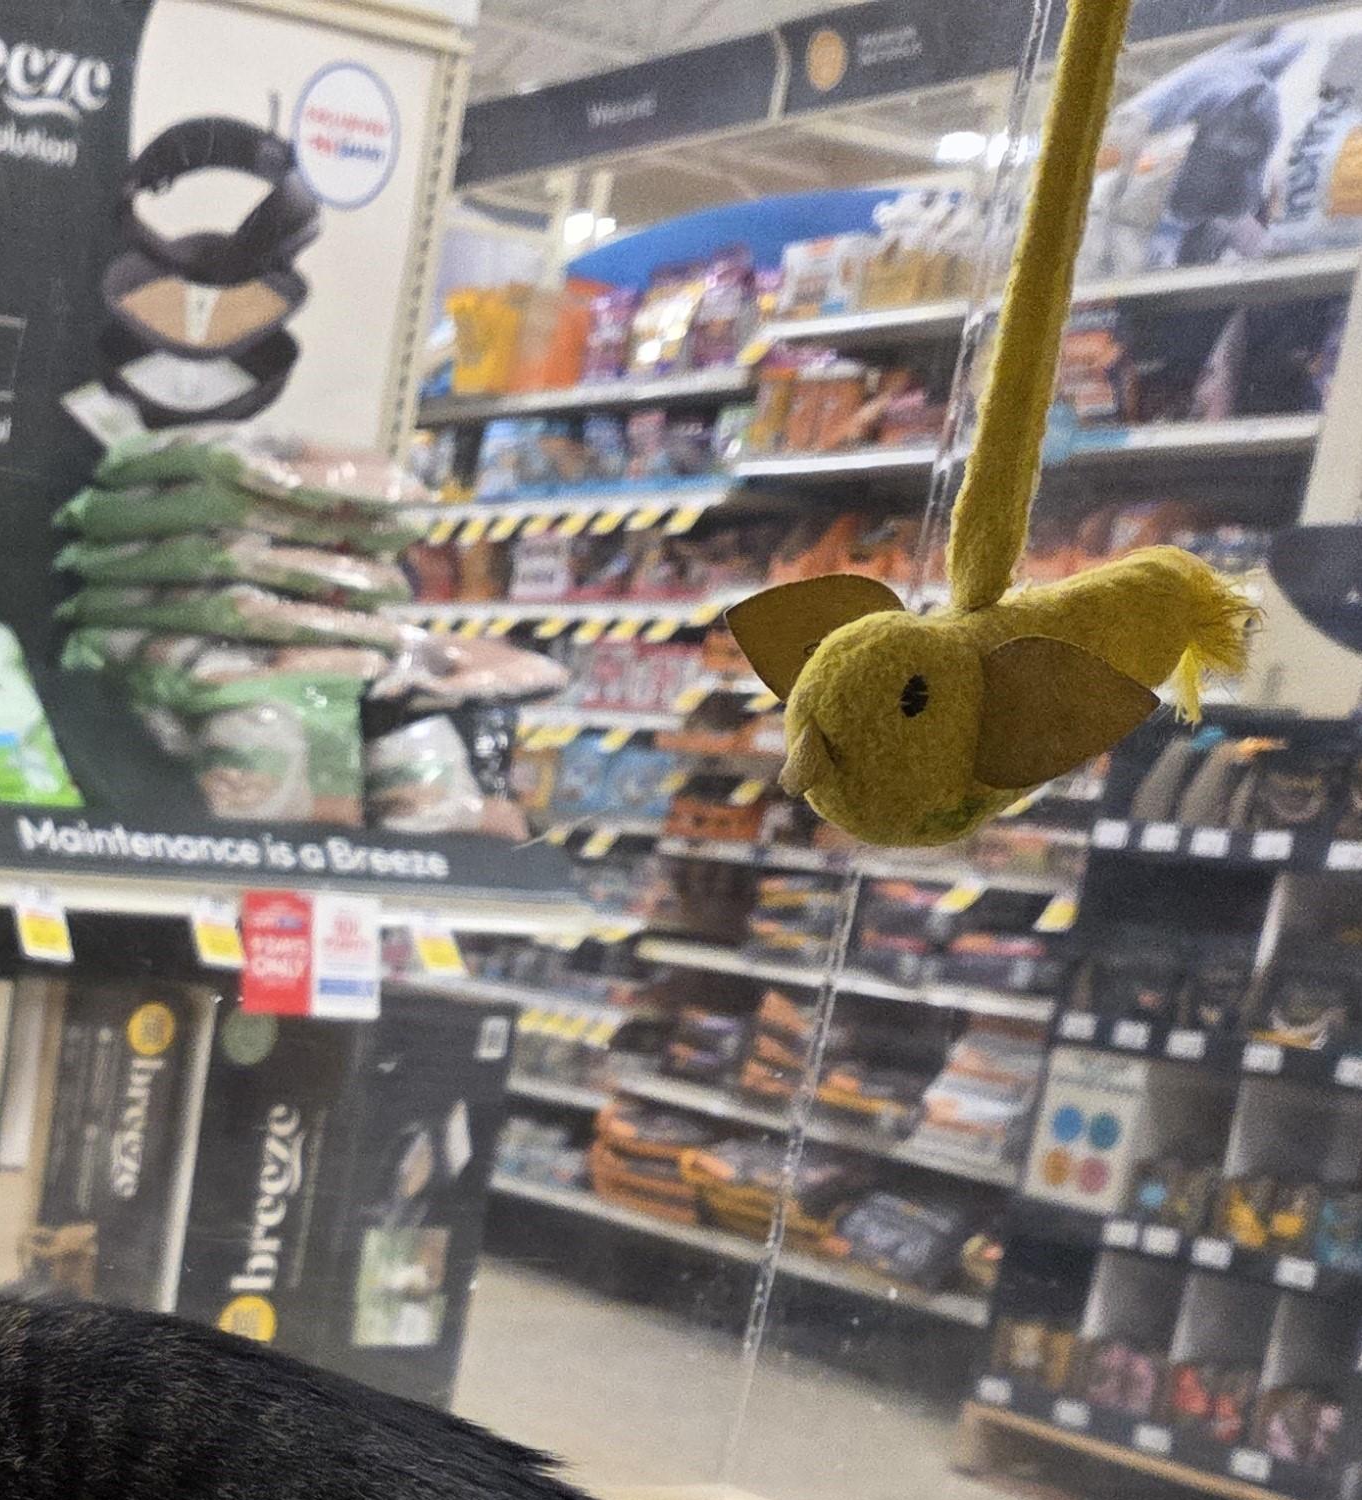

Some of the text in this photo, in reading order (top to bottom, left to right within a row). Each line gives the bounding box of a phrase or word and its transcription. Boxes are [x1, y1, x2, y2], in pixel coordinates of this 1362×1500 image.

[16, 815, 450, 879] Maintenance is a Breeze
[110, 1058, 166, 1199] breeze
[229, 1102, 306, 1293] breeze
